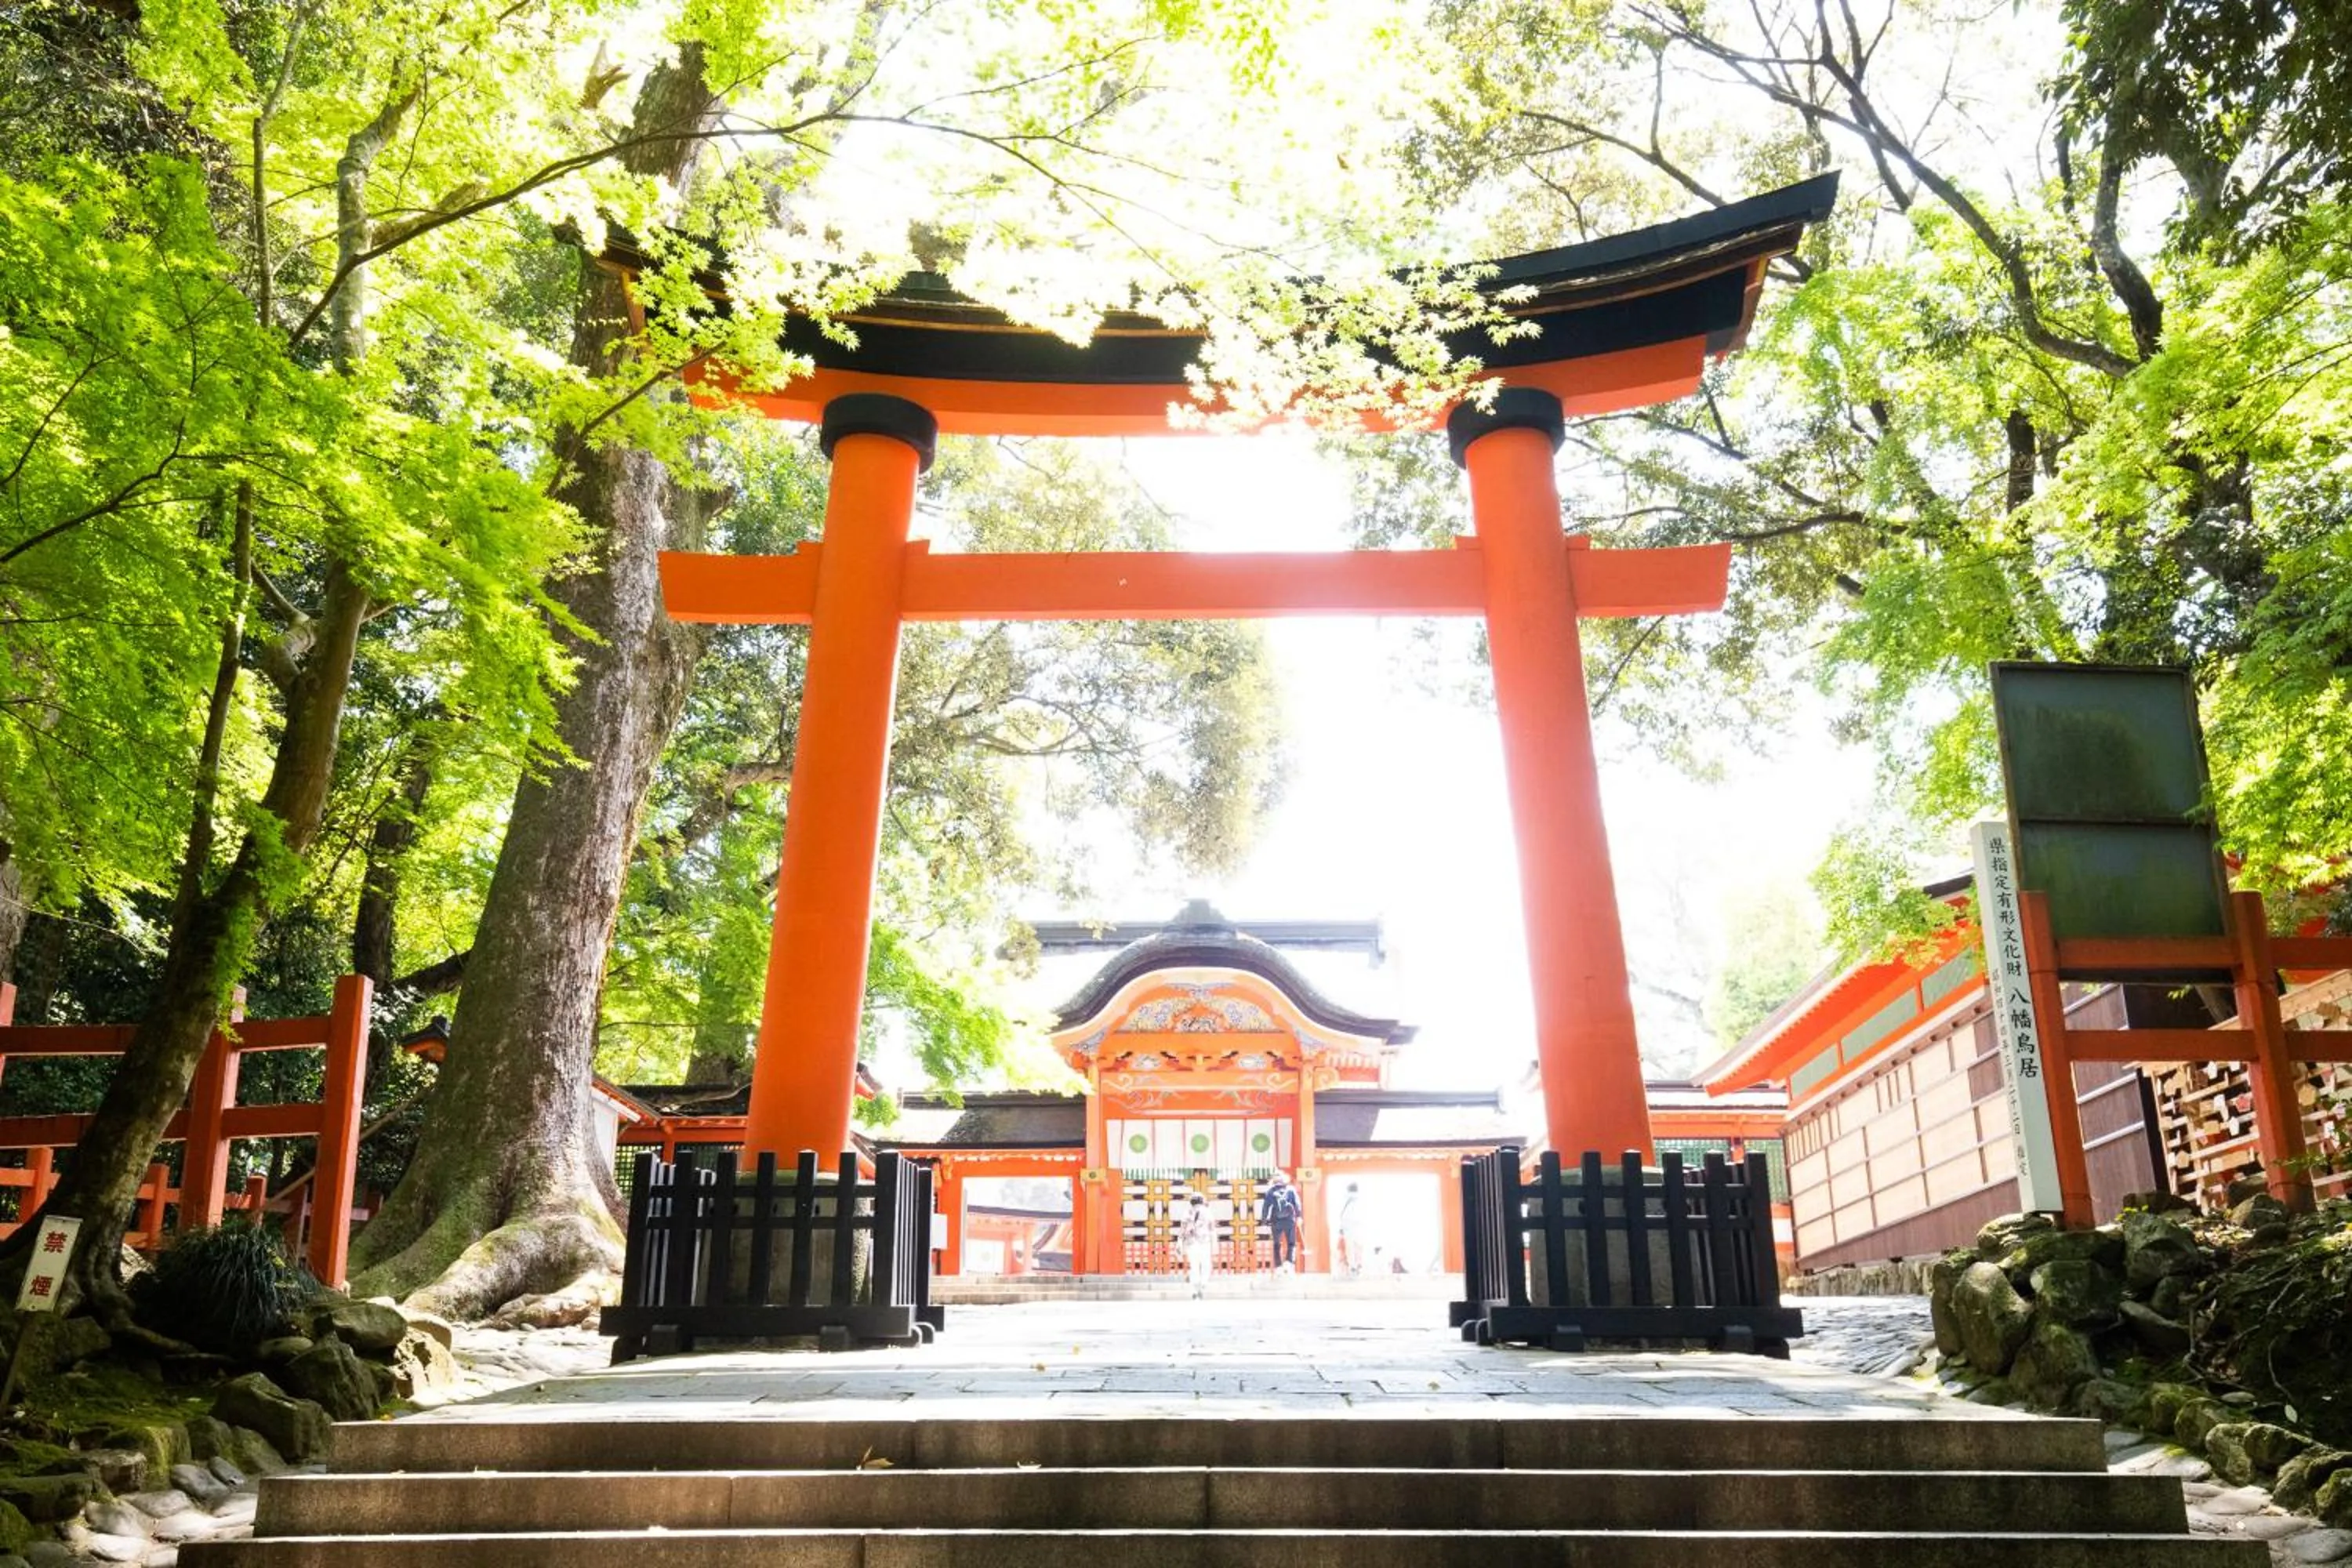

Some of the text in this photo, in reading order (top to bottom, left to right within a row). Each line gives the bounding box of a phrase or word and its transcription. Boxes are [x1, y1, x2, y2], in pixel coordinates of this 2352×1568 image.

[1990, 837, 2038, 1079] 県指定有形文化財 八幡鳥居
[29, 1230, 68, 1297] 禁煙
